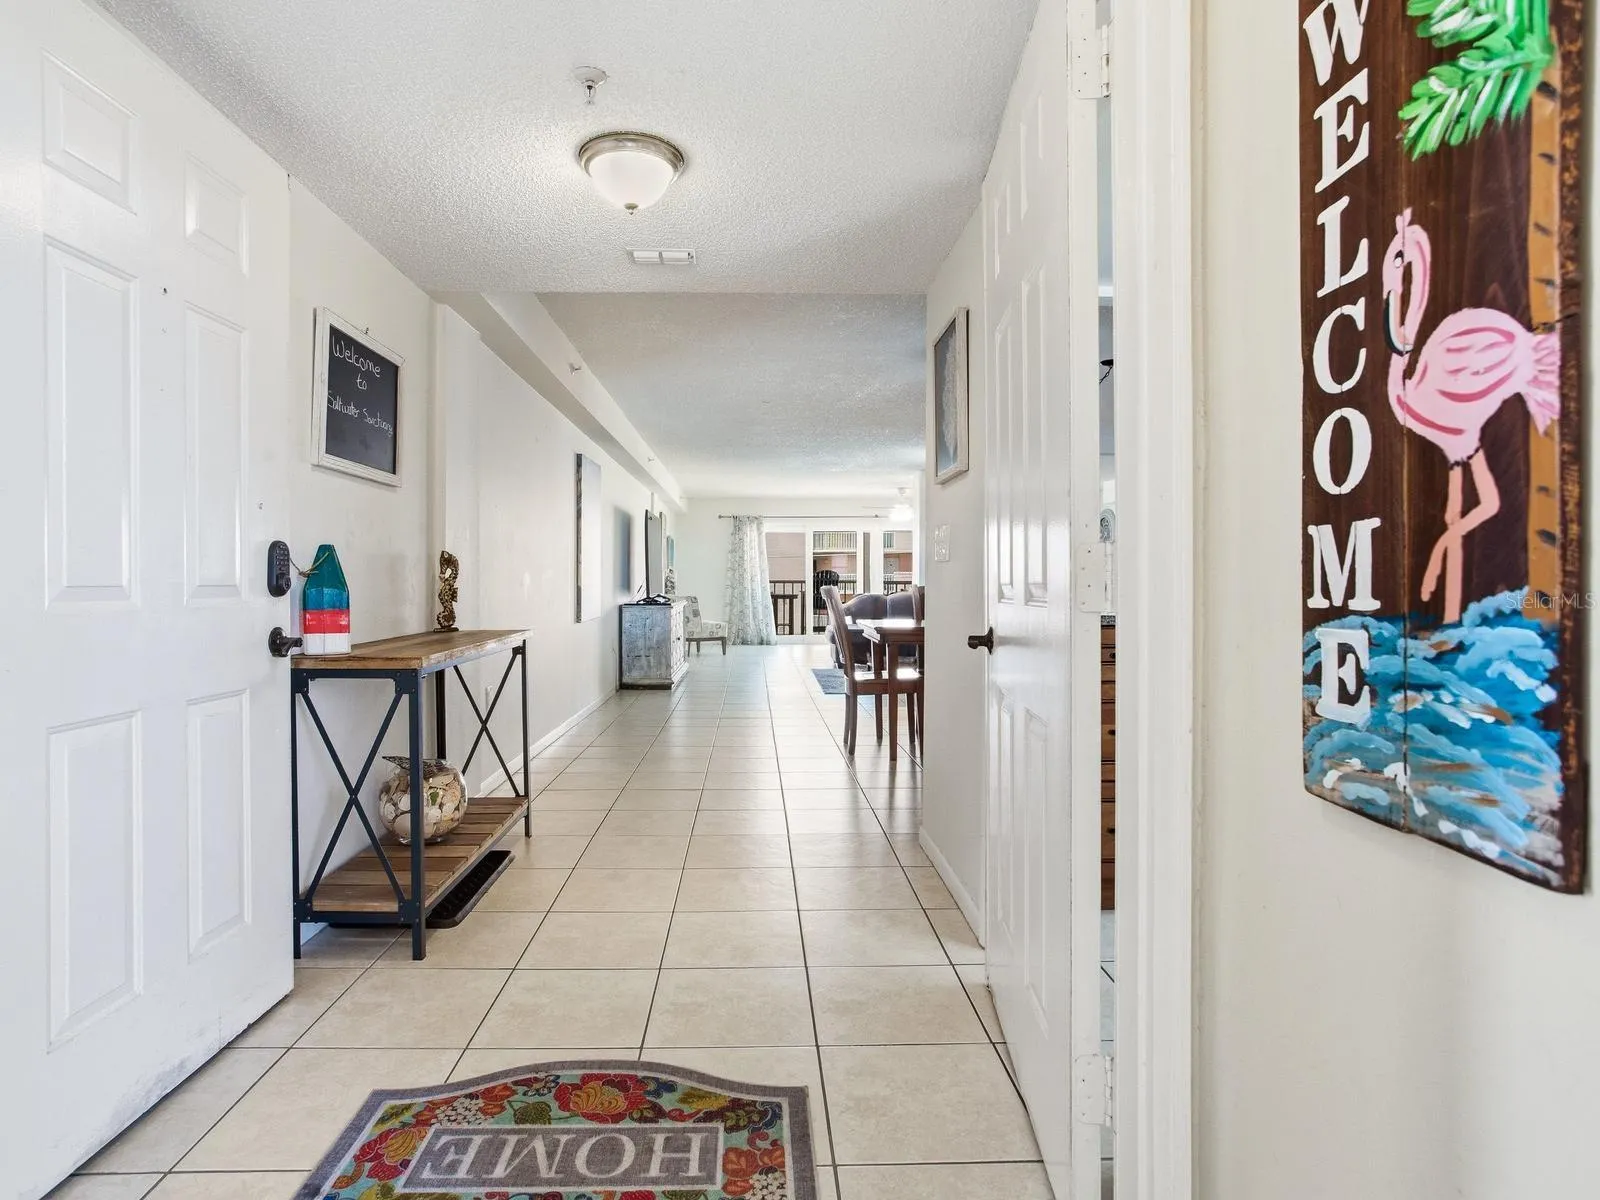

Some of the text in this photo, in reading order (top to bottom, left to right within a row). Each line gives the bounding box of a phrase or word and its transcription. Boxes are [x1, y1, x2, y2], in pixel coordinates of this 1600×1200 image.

[332, 335, 381, 377] Welcome
[1303, 0, 1382, 725] WELCOME
[356, 373, 368, 391] to
[421, 1133, 706, 1179] HOME
